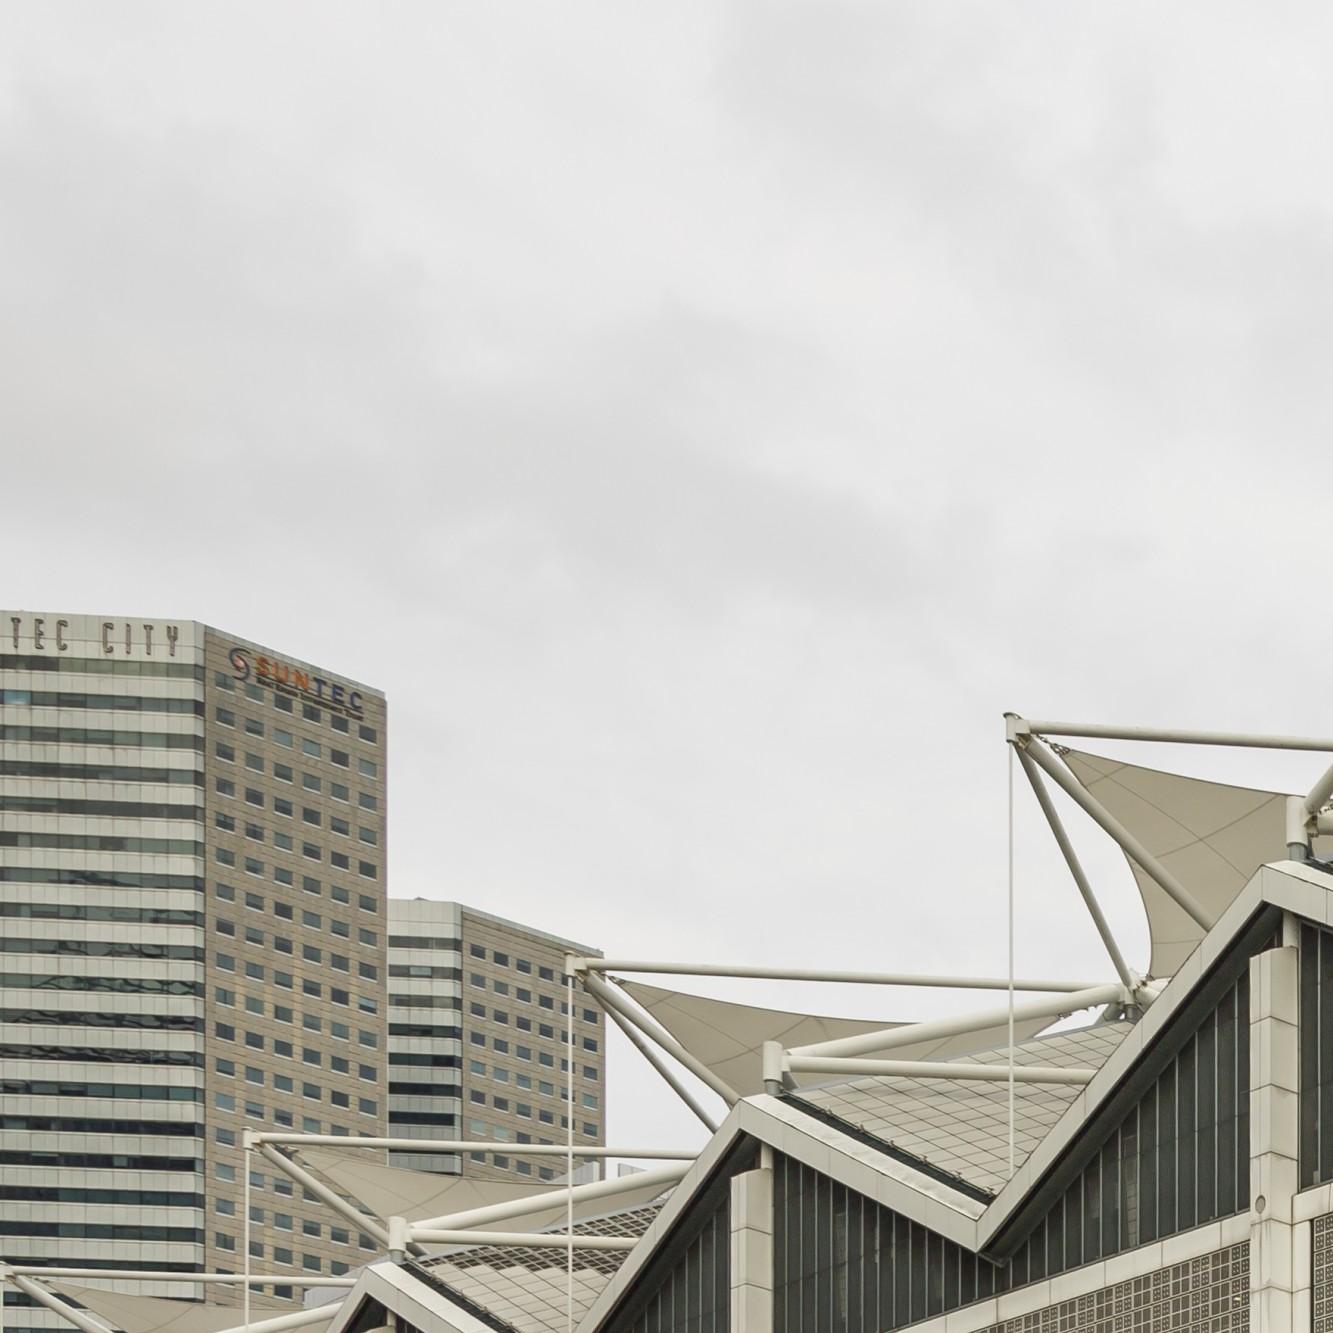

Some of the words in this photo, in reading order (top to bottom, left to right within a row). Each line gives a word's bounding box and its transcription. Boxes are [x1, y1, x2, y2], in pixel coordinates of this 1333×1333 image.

[11, 617, 68, 651] TEC
[103, 622, 178, 656] CITY
[256, 655, 364, 711] SUNTEC
